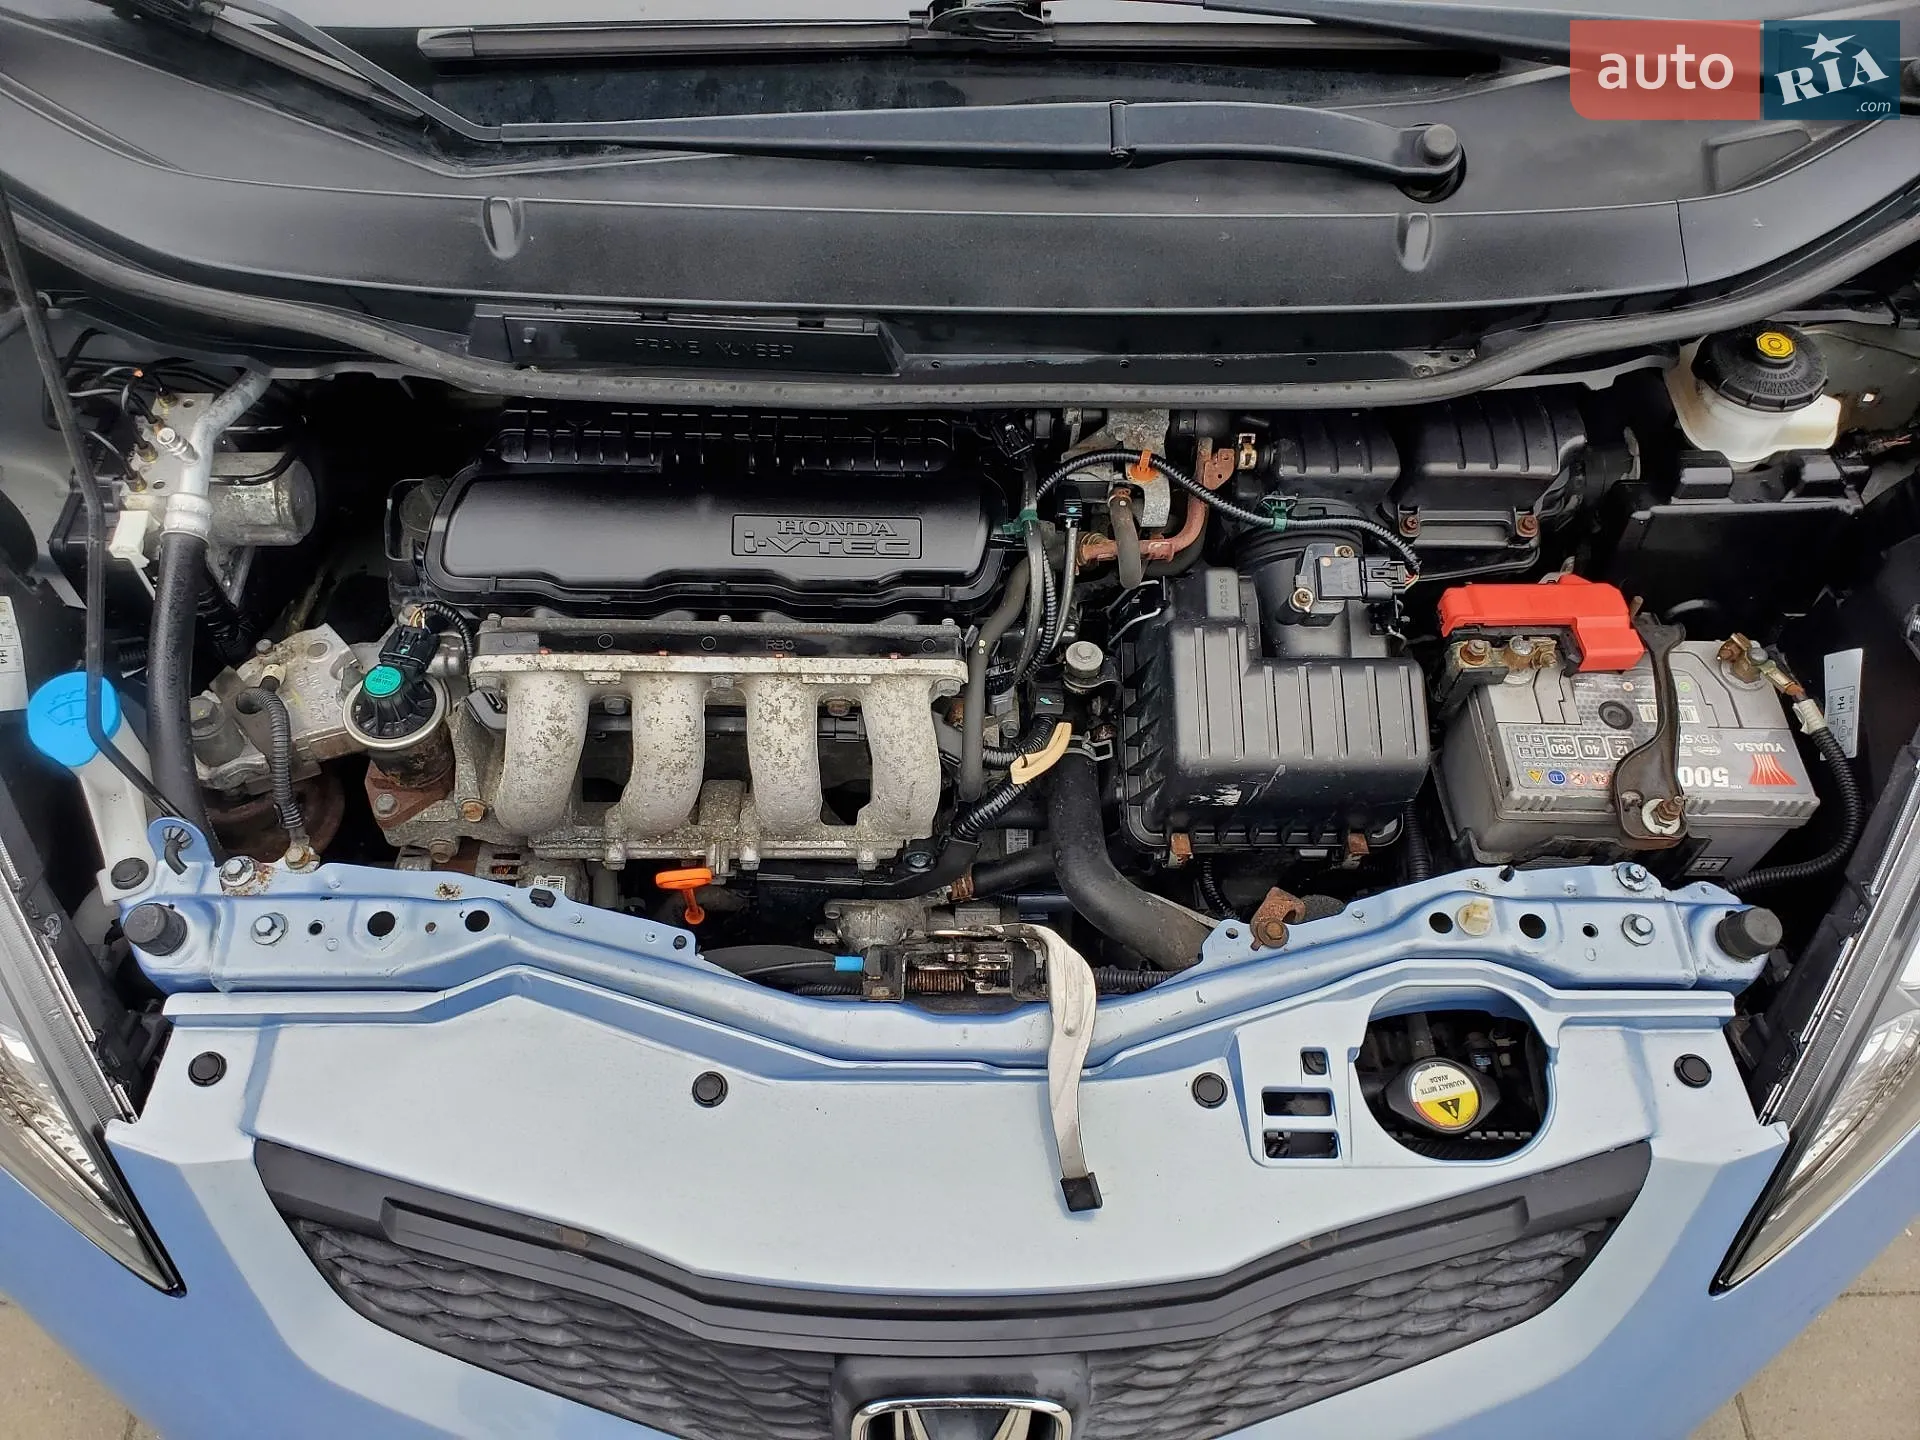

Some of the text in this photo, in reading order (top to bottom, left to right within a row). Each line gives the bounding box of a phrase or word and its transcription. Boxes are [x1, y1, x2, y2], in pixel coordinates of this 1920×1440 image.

[777, 520, 898, 537] HONDA
[743, 530, 911, 556] i-VTEC
[1550, 743, 1575, 755] 360
[1585, 743, 1600, 755] 40
[1733, 741, 1787, 753] YUASA
[1678, 766, 1729, 788] 500
